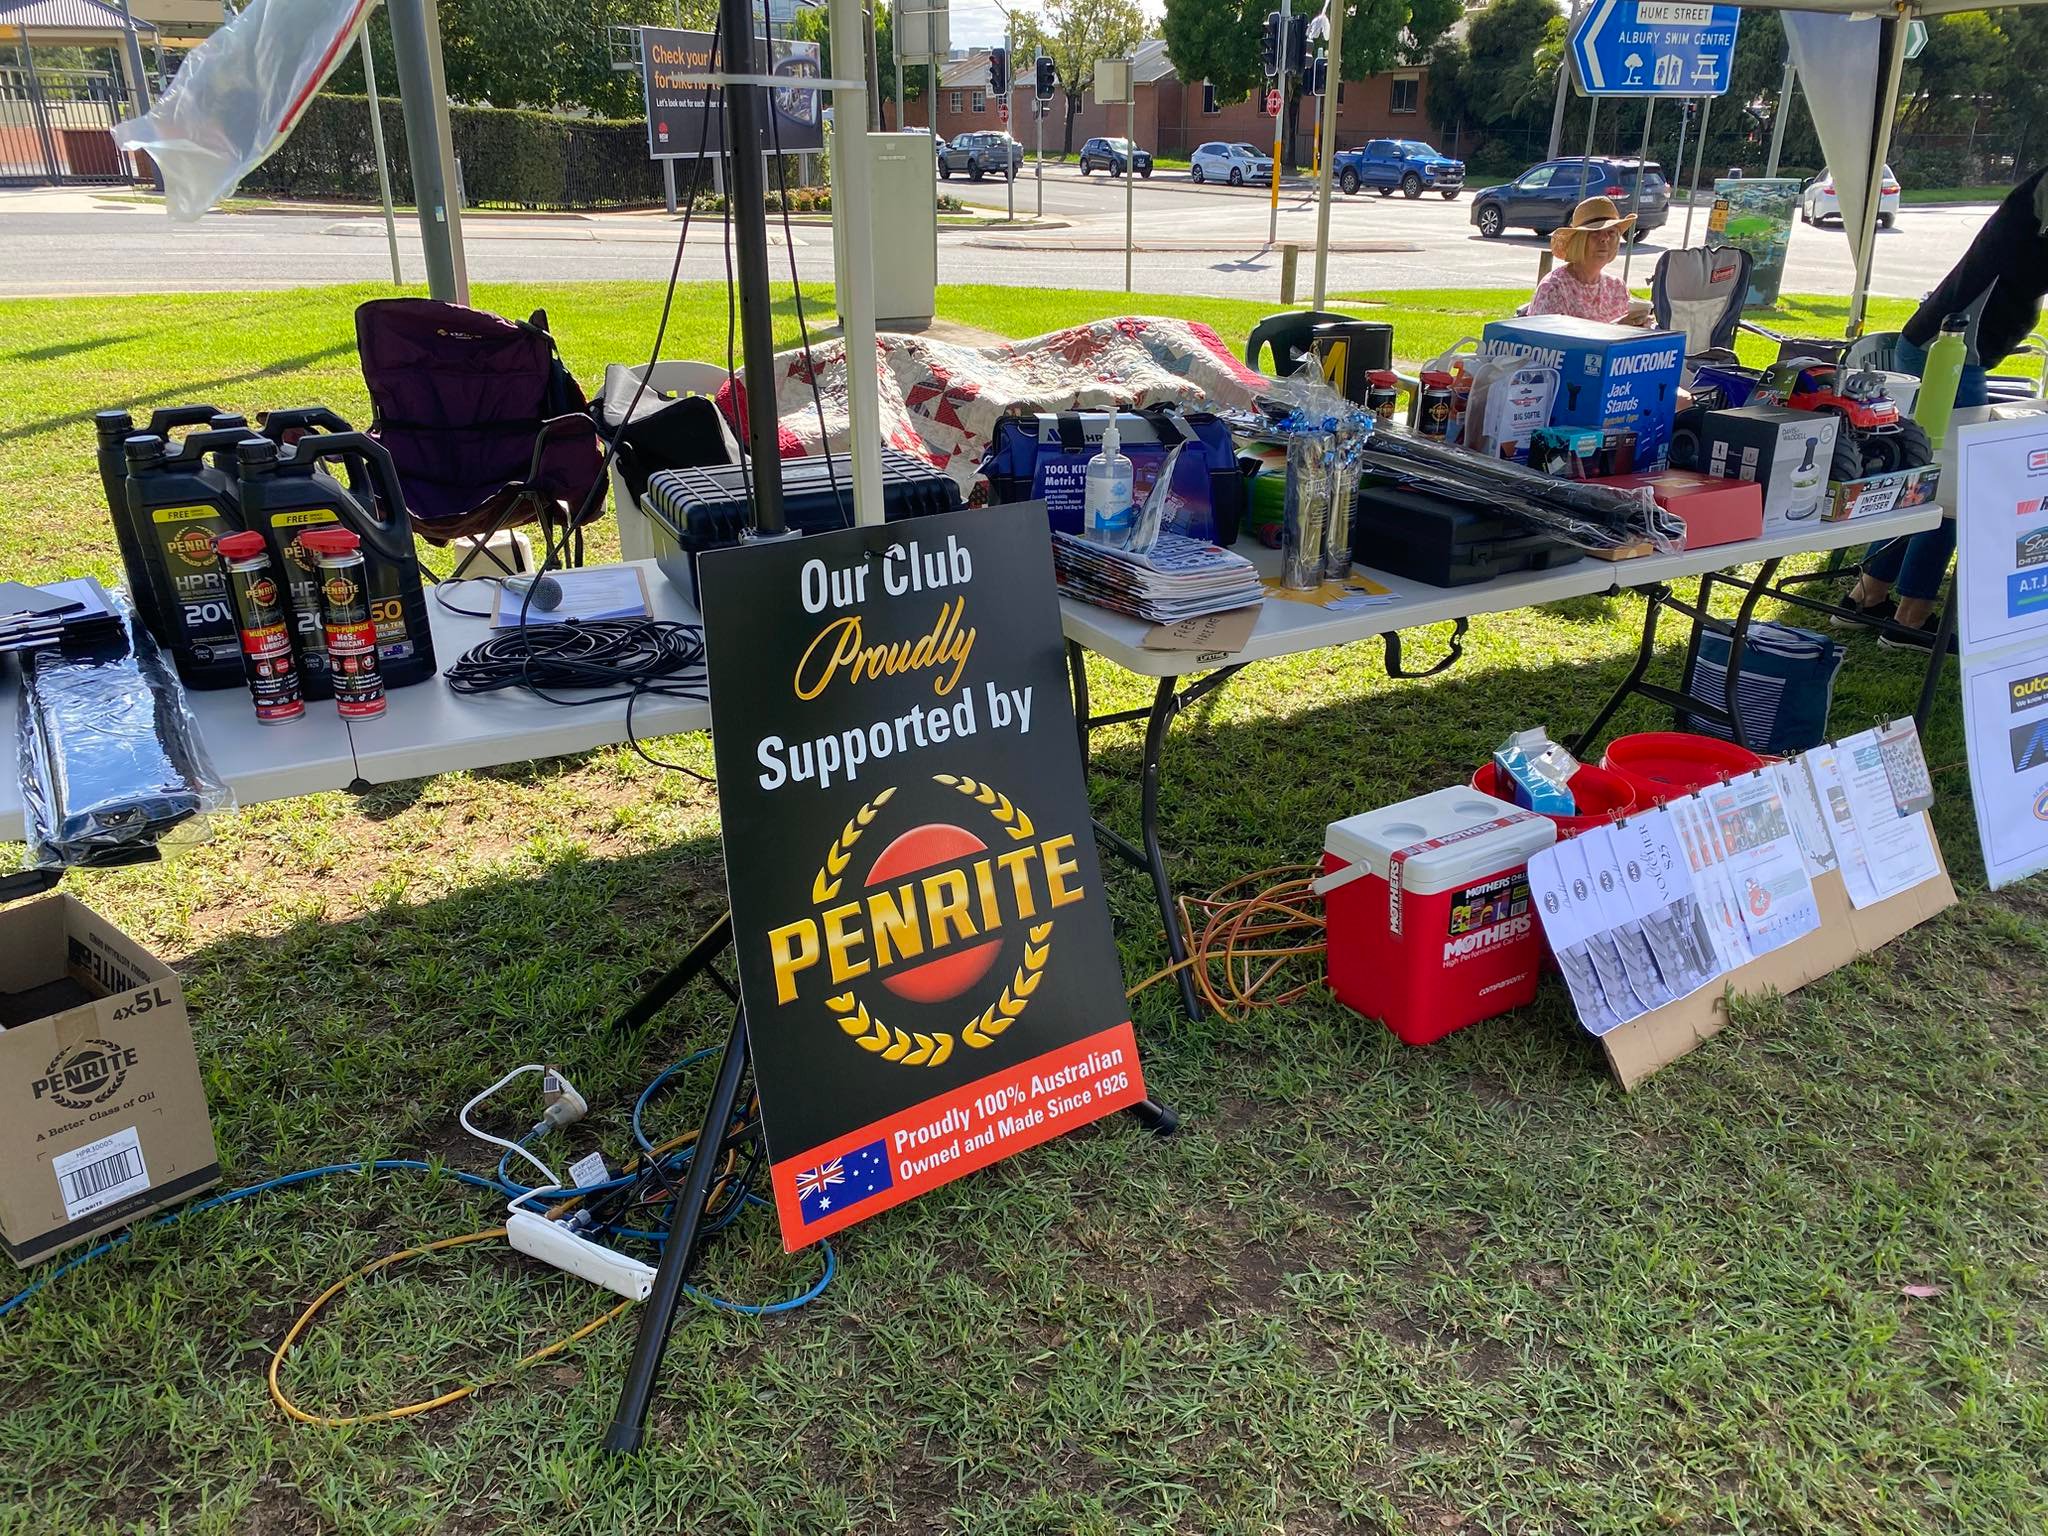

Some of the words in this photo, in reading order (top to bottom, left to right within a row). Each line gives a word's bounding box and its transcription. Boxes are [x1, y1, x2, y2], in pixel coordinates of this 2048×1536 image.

[1640, 7, 1669, 20] HUME
[1674, 8, 1710, 21] STREET
[1618, 31, 1660, 44] ALBURY
[1664, 32, 1690, 45] SWIM
[1694, 33, 1731, 46] CENTRE
[652, 44, 686, 65] Check
[686, 50, 708, 69] your
[654, 71, 672, 89] for
[1266, 98, 1281, 108] STOP
[1609, 349, 1679, 377] KINCROME
[1607, 381, 1632, 398] Jack
[1604, 396, 1639, 414] Stands
[1045, 465, 1069, 475] TOOL
[1071, 464, 1087, 474] KIT
[1045, 476, 1075, 486] Metric
[1859, 500, 1890, 514] CRUISER
[1861, 491, 1893, 505] INFERNO
[168, 510, 190, 519] FREE
[286, 514, 309, 524] FREE
[167, 539, 211, 554] PENRI
[800, 558, 870, 614] Our
[882, 535, 973, 596] Club
[321, 584, 359, 595] PENRITE
[794, 595, 977, 701] Proudly
[756, 686, 977, 790] Supported
[986, 681, 1033, 734] by
[1465, 876, 1511, 899] MOTHERS
[1389, 860, 1400, 934] MOTHERS
[767, 833, 1086, 1007] PENRITE
[1443, 912, 1532, 961] MOTHERS
[1443, 956, 1459, 968] High
[31, 1047, 139, 1100] PENRITE
[894, 1107, 970, 1154] Proudly
[974, 1083, 1026, 1120] 100%
[1030, 1049, 1123, 1099] Australian
[36, 1133, 46, 1142] A
[48, 1119, 85, 1138] Better
[89, 1107, 120, 1122] Class
[123, 1098, 135, 1110] of
[137, 1091, 156, 1103] Oil
[899, 1143, 960, 1181] Owned
[965, 1125, 994, 1153] and
[997, 1108, 1044, 1139] Made
[1048, 1089, 1092, 1118] Since
[1094, 1071, 1129, 1099] 1926
[77, 1200, 103, 1215] PENRITE
